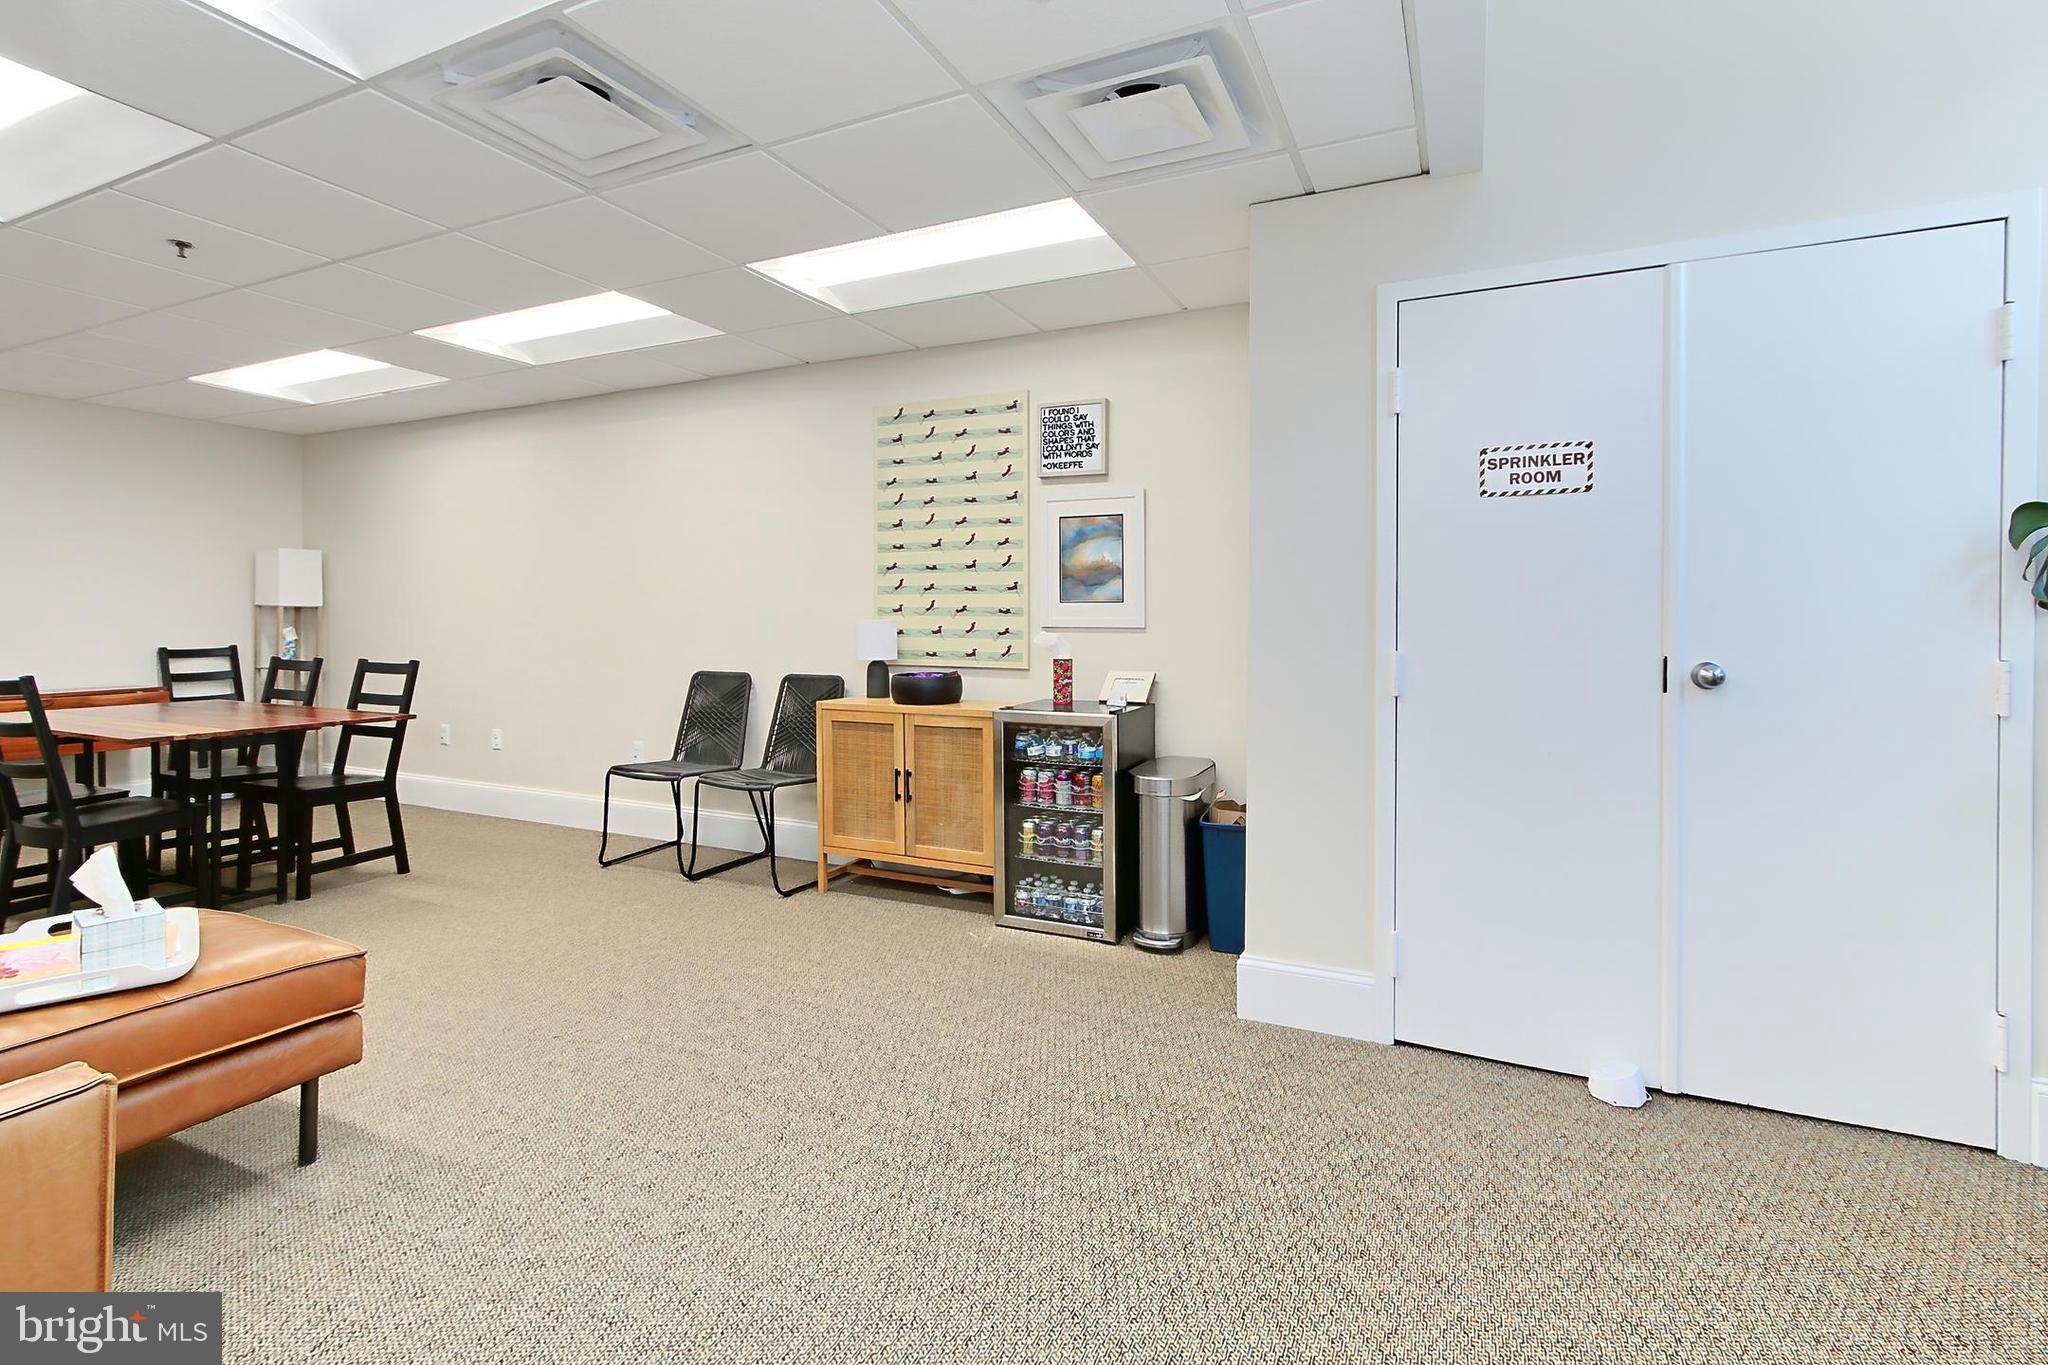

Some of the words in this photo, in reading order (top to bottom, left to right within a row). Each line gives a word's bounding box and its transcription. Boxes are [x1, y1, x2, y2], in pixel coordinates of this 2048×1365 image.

[1048, 407, 1076, 416] FOUND
[1042, 415, 1070, 423] COULD
[1073, 413, 1088, 421] SAY
[1042, 422, 1073, 430] THINGS
[1074, 420, 1094, 428] WITH
[1042, 429, 1075, 438] COLORS
[1077, 427, 1095, 436] AND
[1042, 437, 1074, 445] SHAPES
[1076, 435, 1096, 443] THAT
[1085, 442, 1100, 450] SAY
[1042, 452, 1062, 460] WITH
[1064, 450, 1093, 458] WORDS
[1487, 452, 1585, 470] SPRINKLER
[1509, 470, 1561, 485] ROOM
